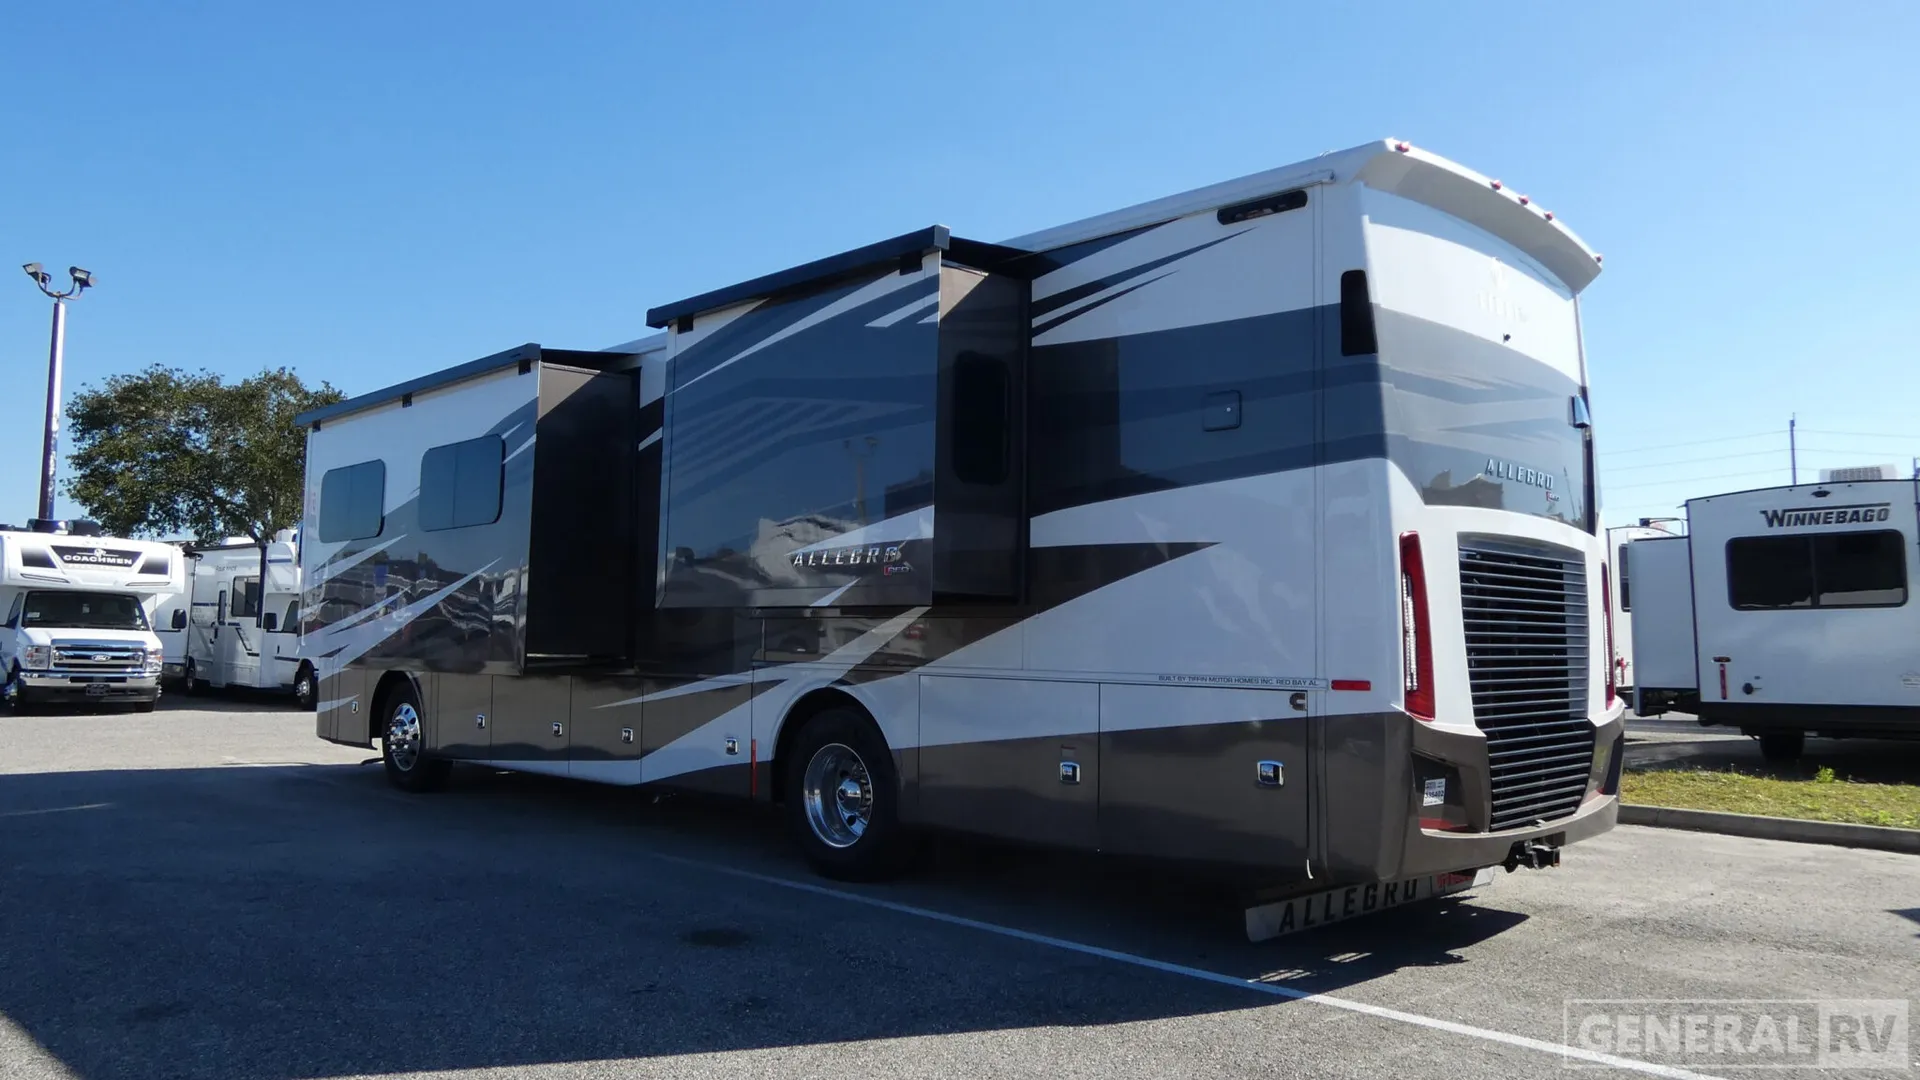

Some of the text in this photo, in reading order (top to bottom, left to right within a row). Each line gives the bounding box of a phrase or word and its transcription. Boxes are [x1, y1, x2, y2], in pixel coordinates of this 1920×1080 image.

[1484, 458, 1554, 491] ALLEGRO
[1759, 502, 1891, 528] WINNEBAGO
[62, 554, 133, 566] COACHMEN
[793, 546, 899, 567] ALLEGRO
[1279, 877, 1418, 933] ALLEGRO
